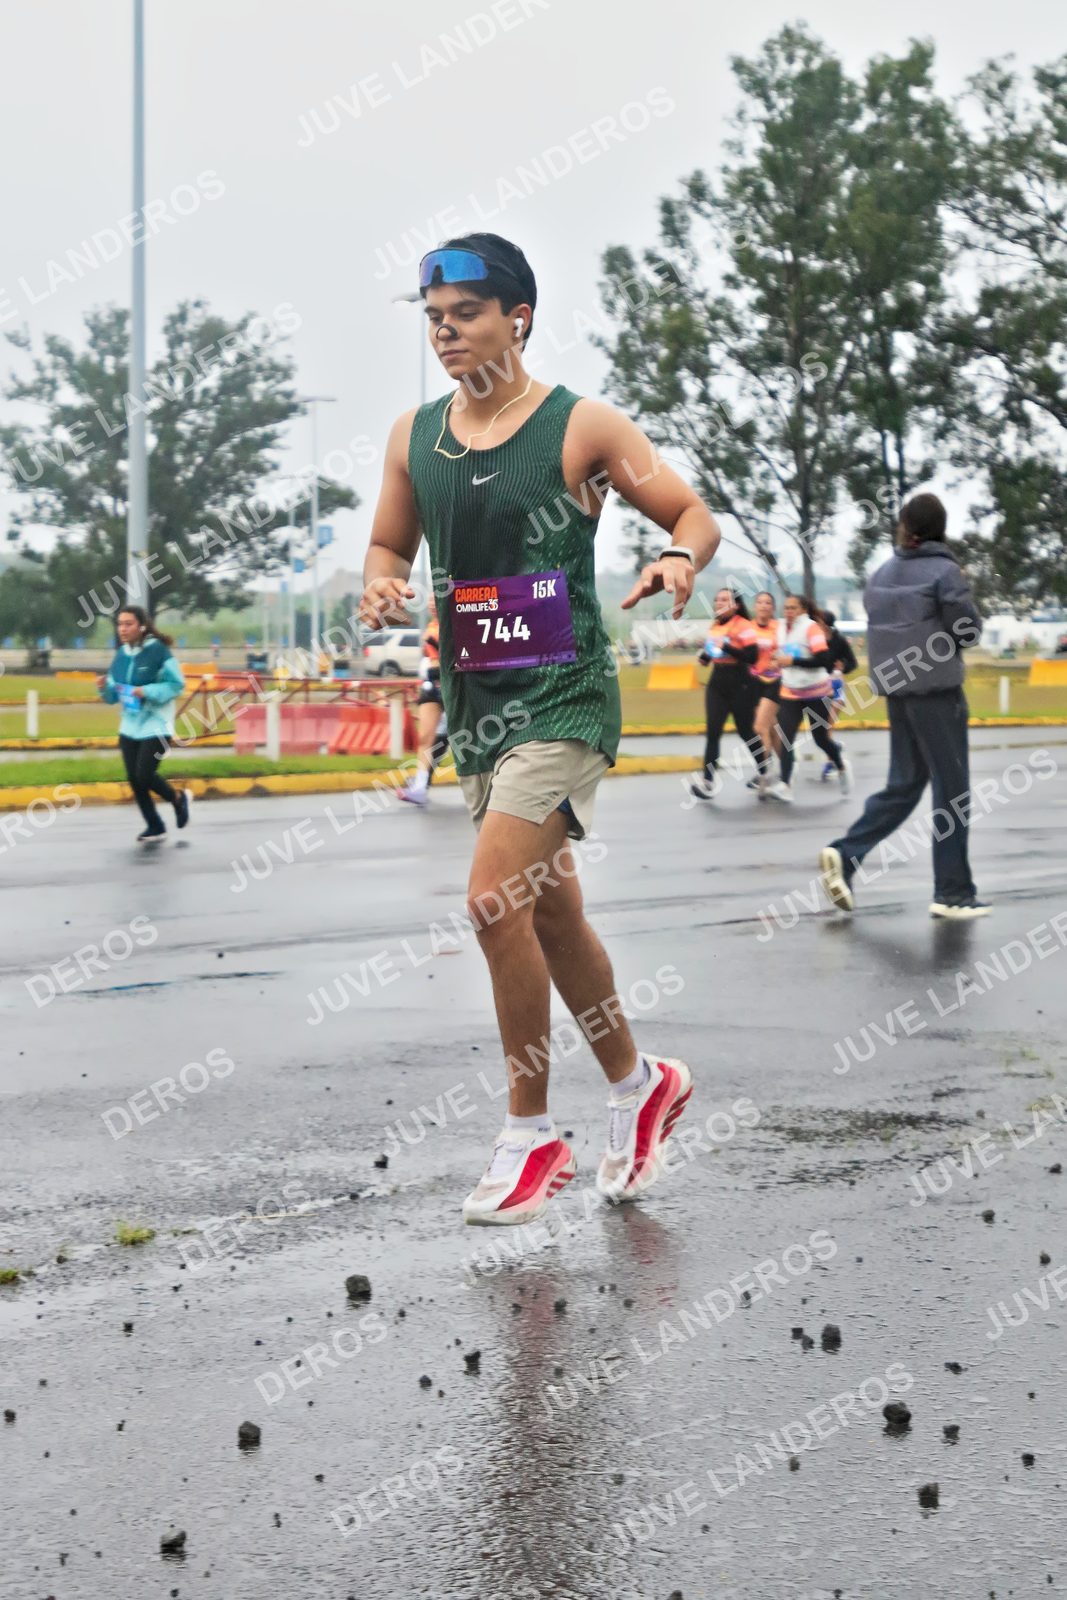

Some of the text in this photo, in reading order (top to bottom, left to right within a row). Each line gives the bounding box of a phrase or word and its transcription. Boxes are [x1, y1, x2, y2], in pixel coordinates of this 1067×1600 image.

[455, 585, 498, 603] CARRERA
[532, 579, 556, 599] 15K
[477, 615, 531, 644] 744
